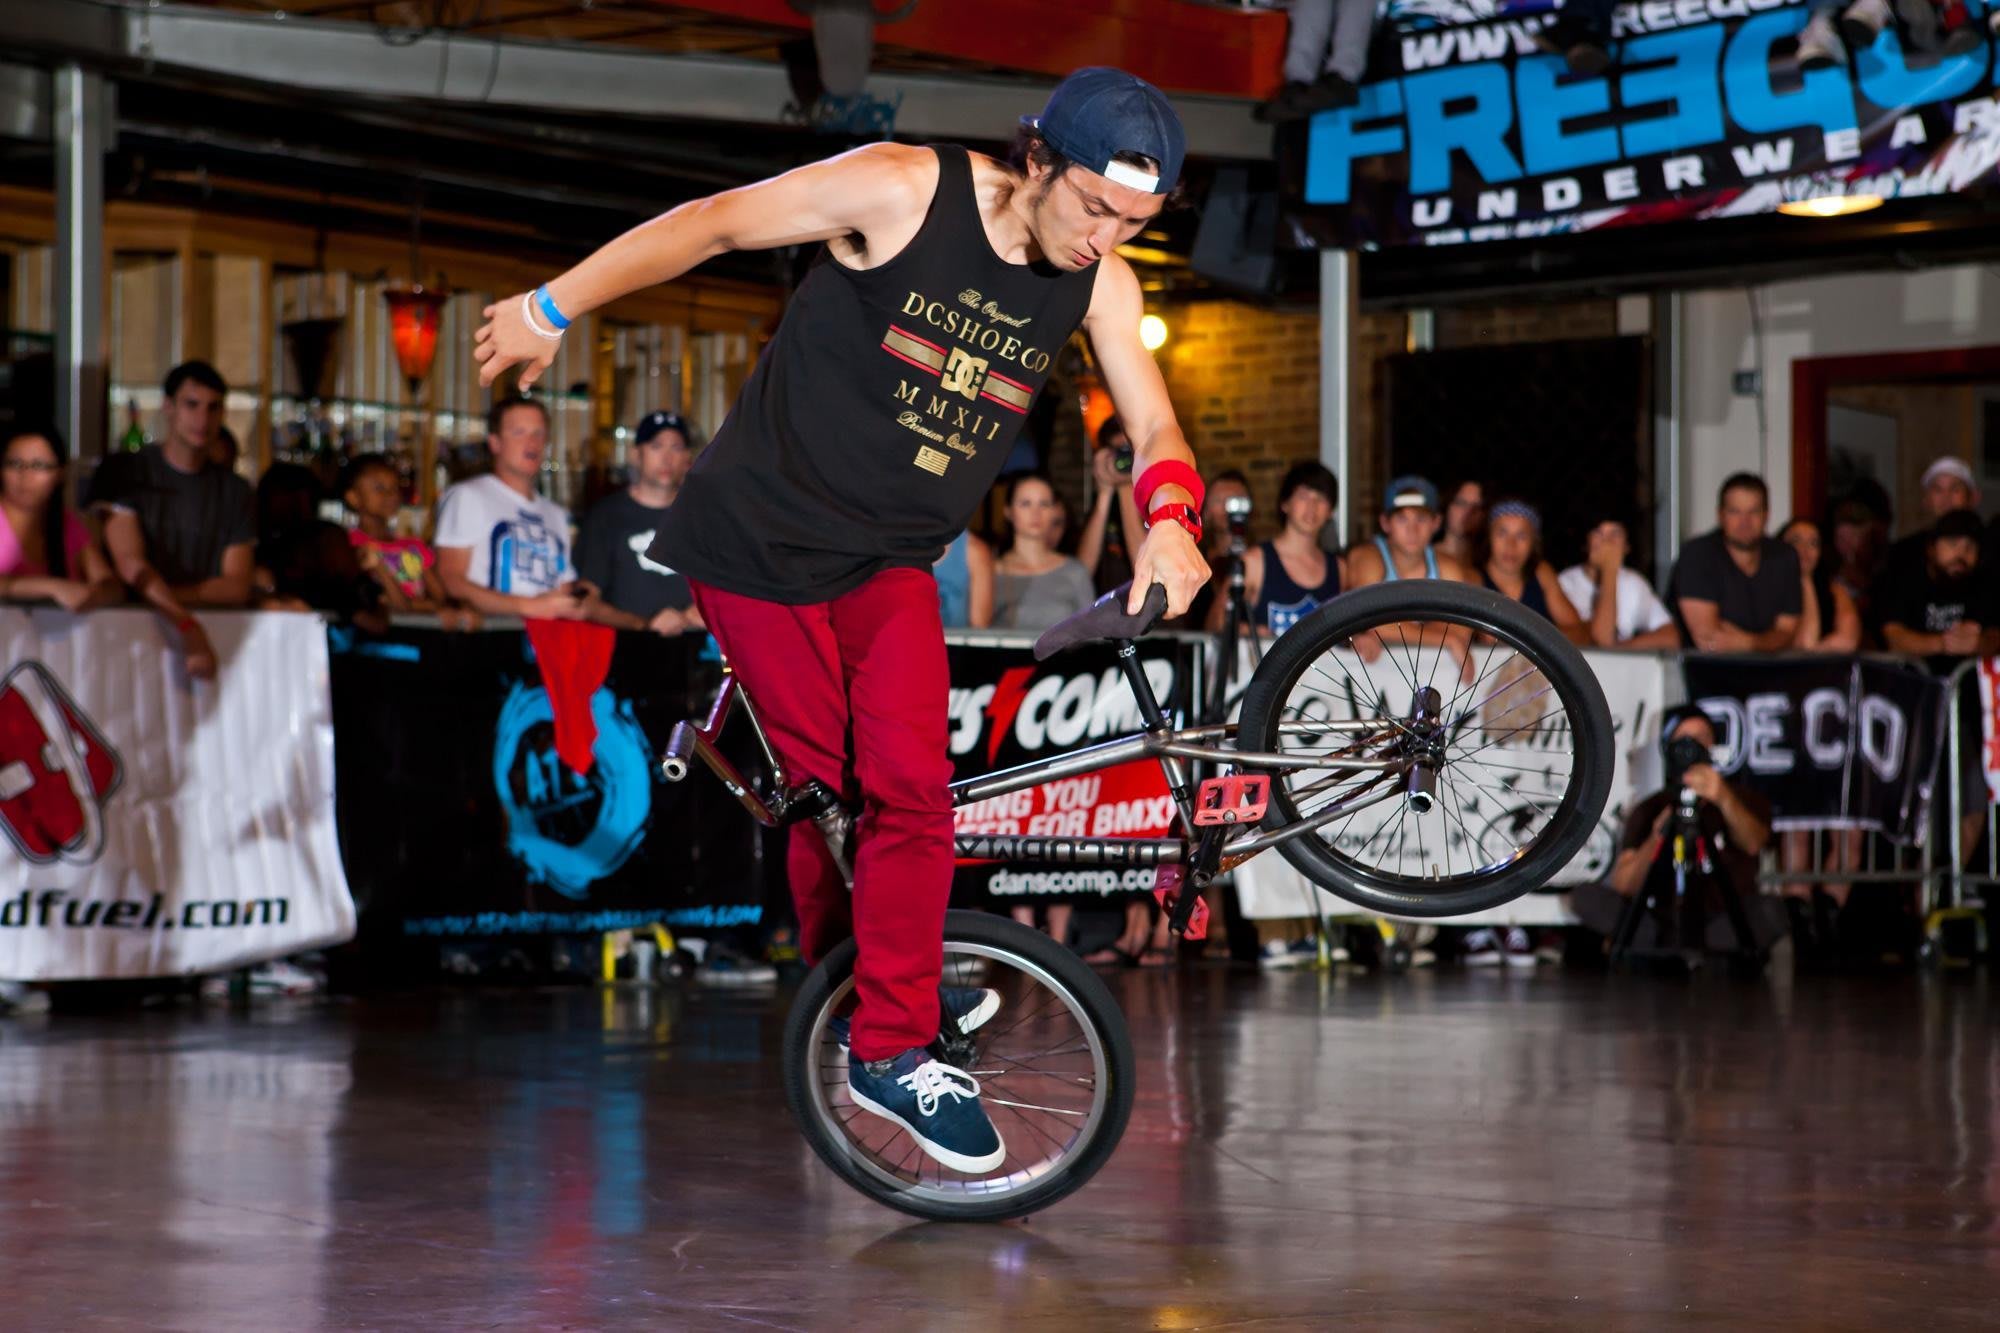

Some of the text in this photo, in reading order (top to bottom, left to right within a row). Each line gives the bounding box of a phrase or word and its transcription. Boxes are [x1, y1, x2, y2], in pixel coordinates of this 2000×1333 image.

[1304, 0, 2000, 204] FREEGU
[1411, 97, 2000, 227] UNDERWEAR
[901, 291, 1050, 373] DCSHOECO
[957, 288, 1032, 329] The Original
[896, 411, 977, 461] Premium Quality
[1015, 658, 1174, 750] COMP
[1695, 688, 1908, 782] DECO
[1041, 776, 1102, 813] YOU
[988, 868, 1156, 898] danscomp.co
